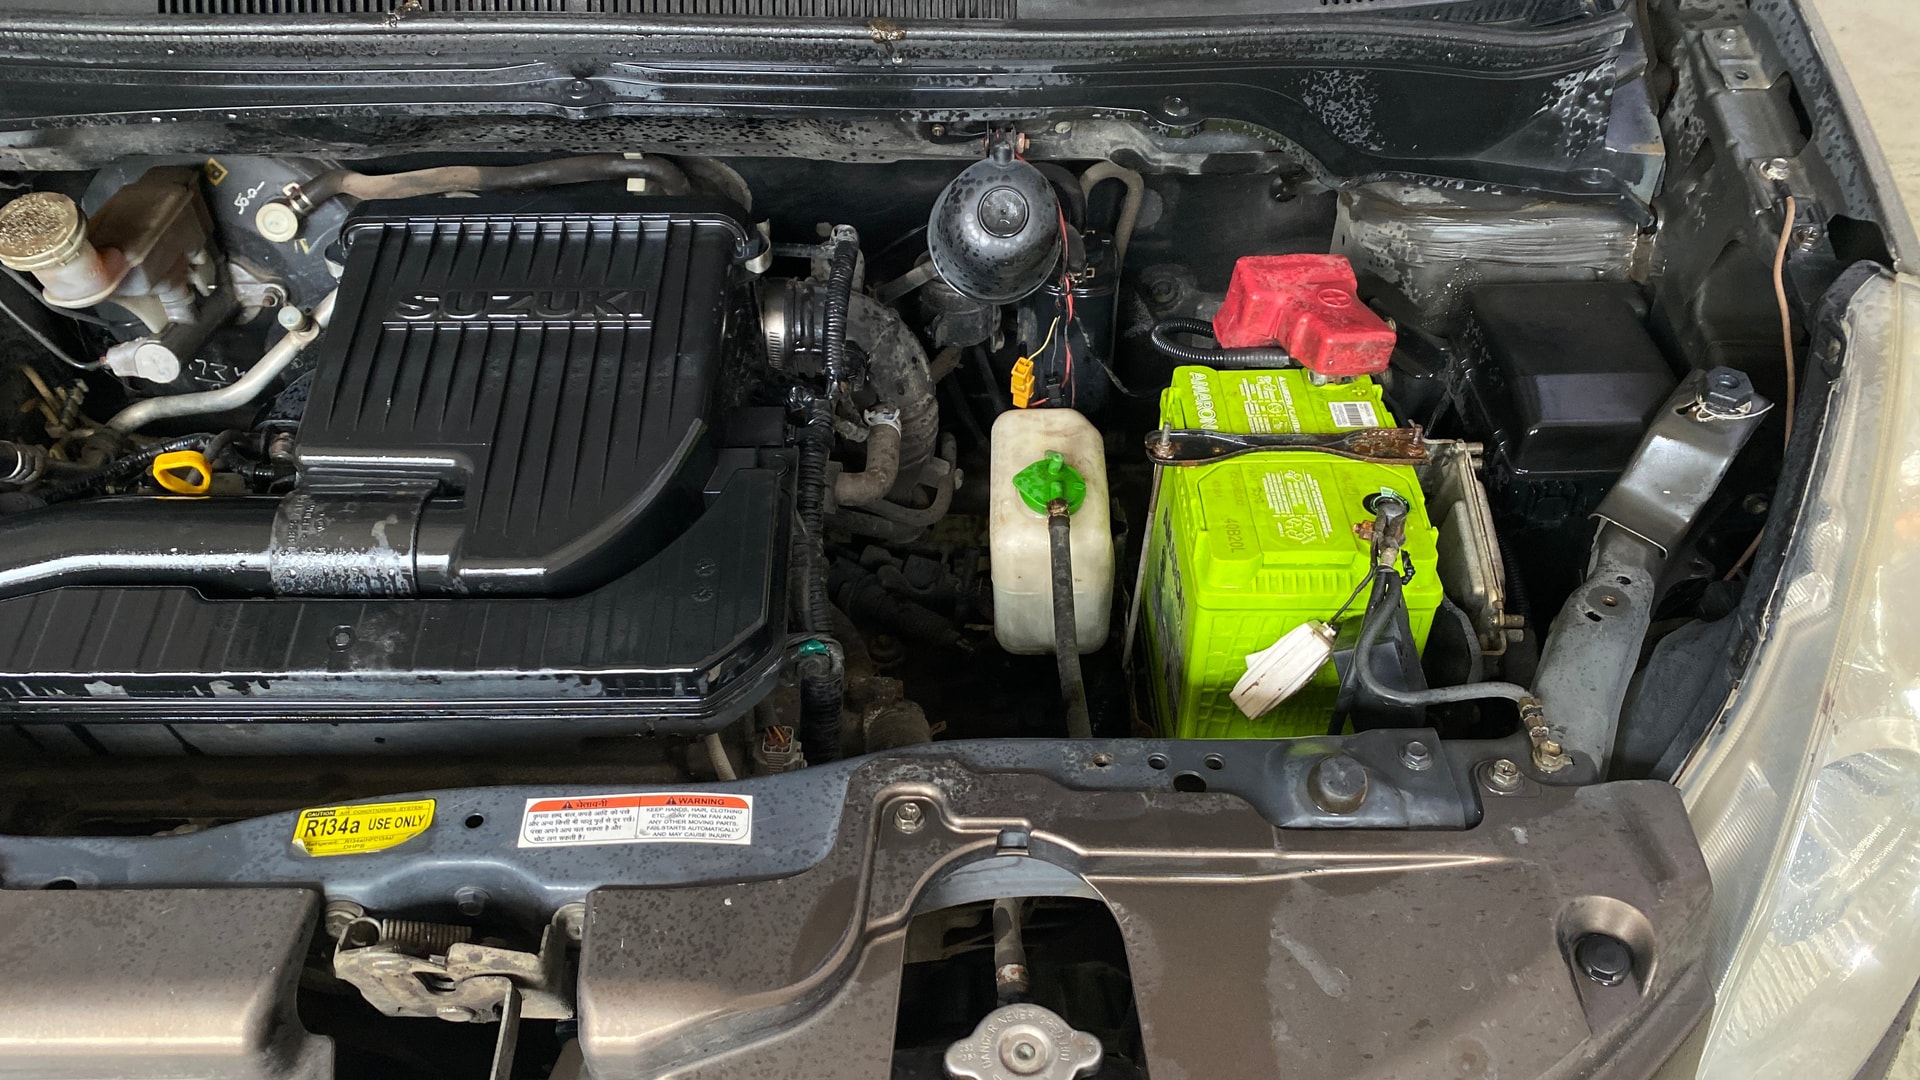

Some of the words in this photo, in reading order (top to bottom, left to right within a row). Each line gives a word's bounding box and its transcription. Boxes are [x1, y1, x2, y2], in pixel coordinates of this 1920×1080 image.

[395, 288, 648, 321] SUZUKI
[1188, 371, 1219, 431] AMARON
[576, 799, 608, 808] चेतावनी
[678, 798, 725, 806] WARNING
[306, 810, 336, 818] CAUTION
[304, 817, 361, 838] R134a
[368, 817, 392, 831] USE
[394, 814, 426, 828] ONLY
[997, 1009, 1035, 1025] NEVER
